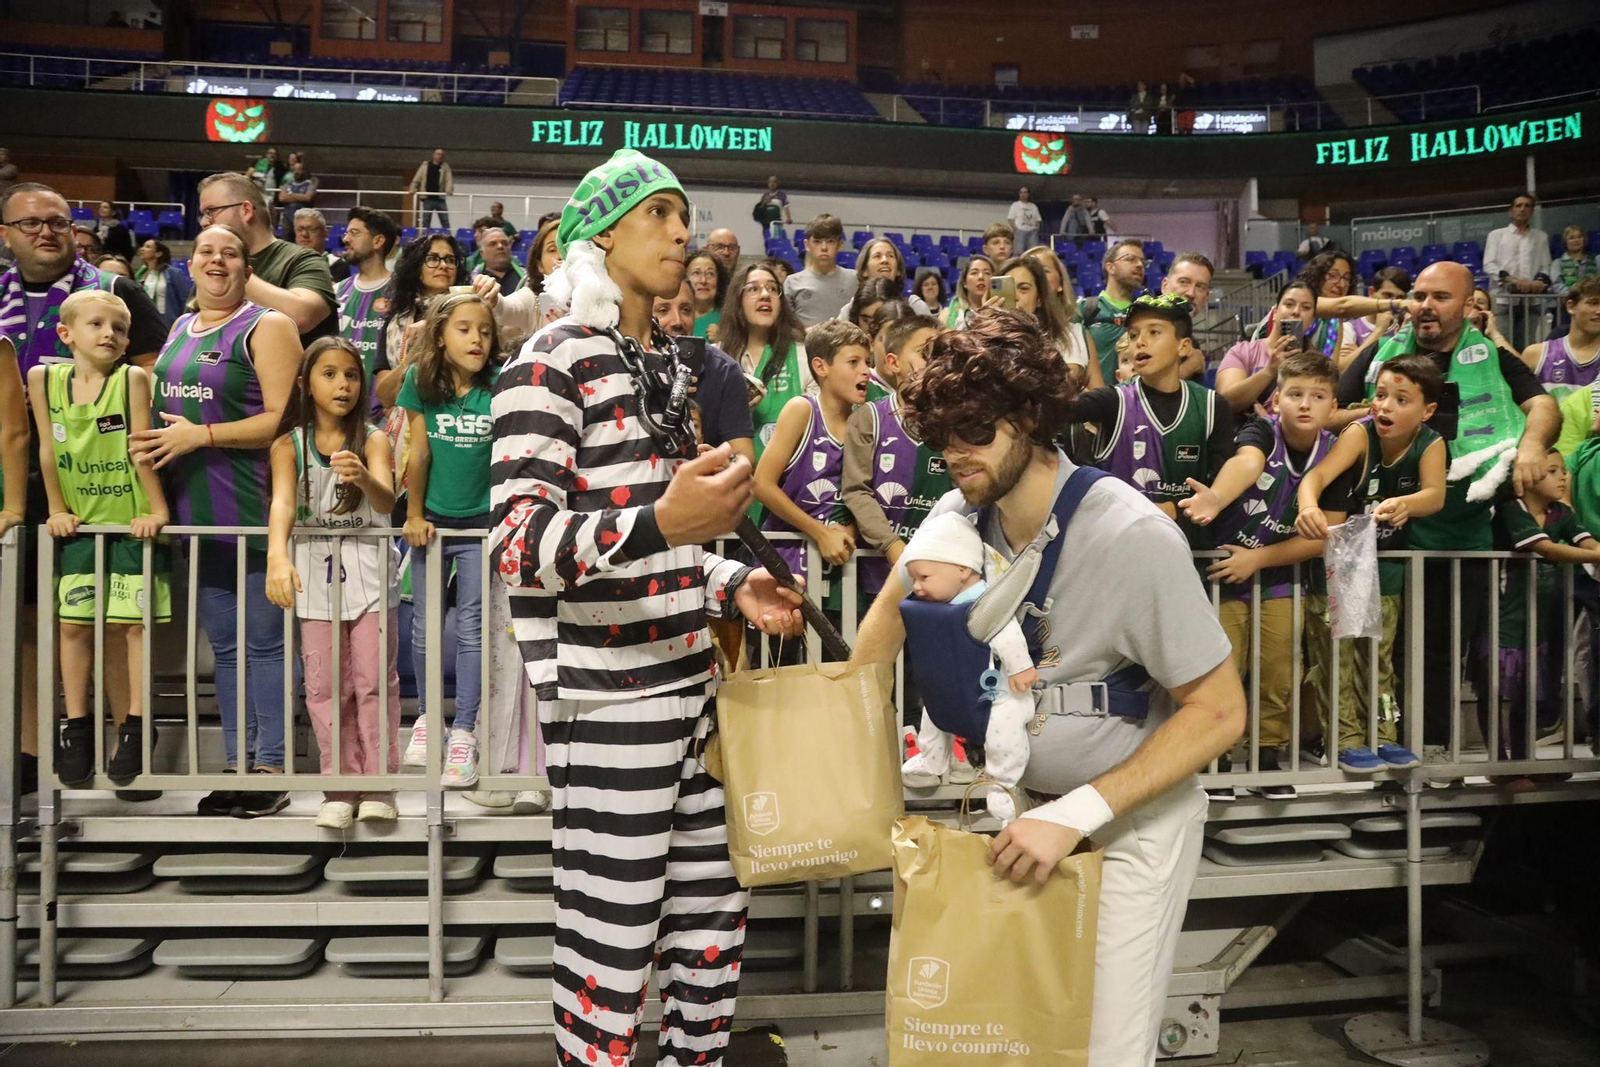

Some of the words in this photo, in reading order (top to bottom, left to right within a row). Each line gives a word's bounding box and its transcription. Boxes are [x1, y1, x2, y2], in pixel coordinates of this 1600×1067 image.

[532, 120, 604, 146] FELIZ
[624, 120, 772, 152] HALLOWEEN
[1316, 136, 1389, 165] FELIZ
[1411, 112, 1582, 162] HALLOWEEN
[160, 381, 214, 403] Unicaja
[435, 413, 493, 435] PGS
[77, 457, 129, 474] Unicaj
[749, 841, 814, 858] Siempre
[817, 838, 833, 850] te
[751, 861, 788, 875] llevo
[792, 850, 858, 868] conmigo
[903, 1016, 981, 1040] Siempre
[986, 1021, 1004, 1036] te
[903, 1033, 948, 1053] llevo
[951, 1038, 1030, 1057] conmigo
